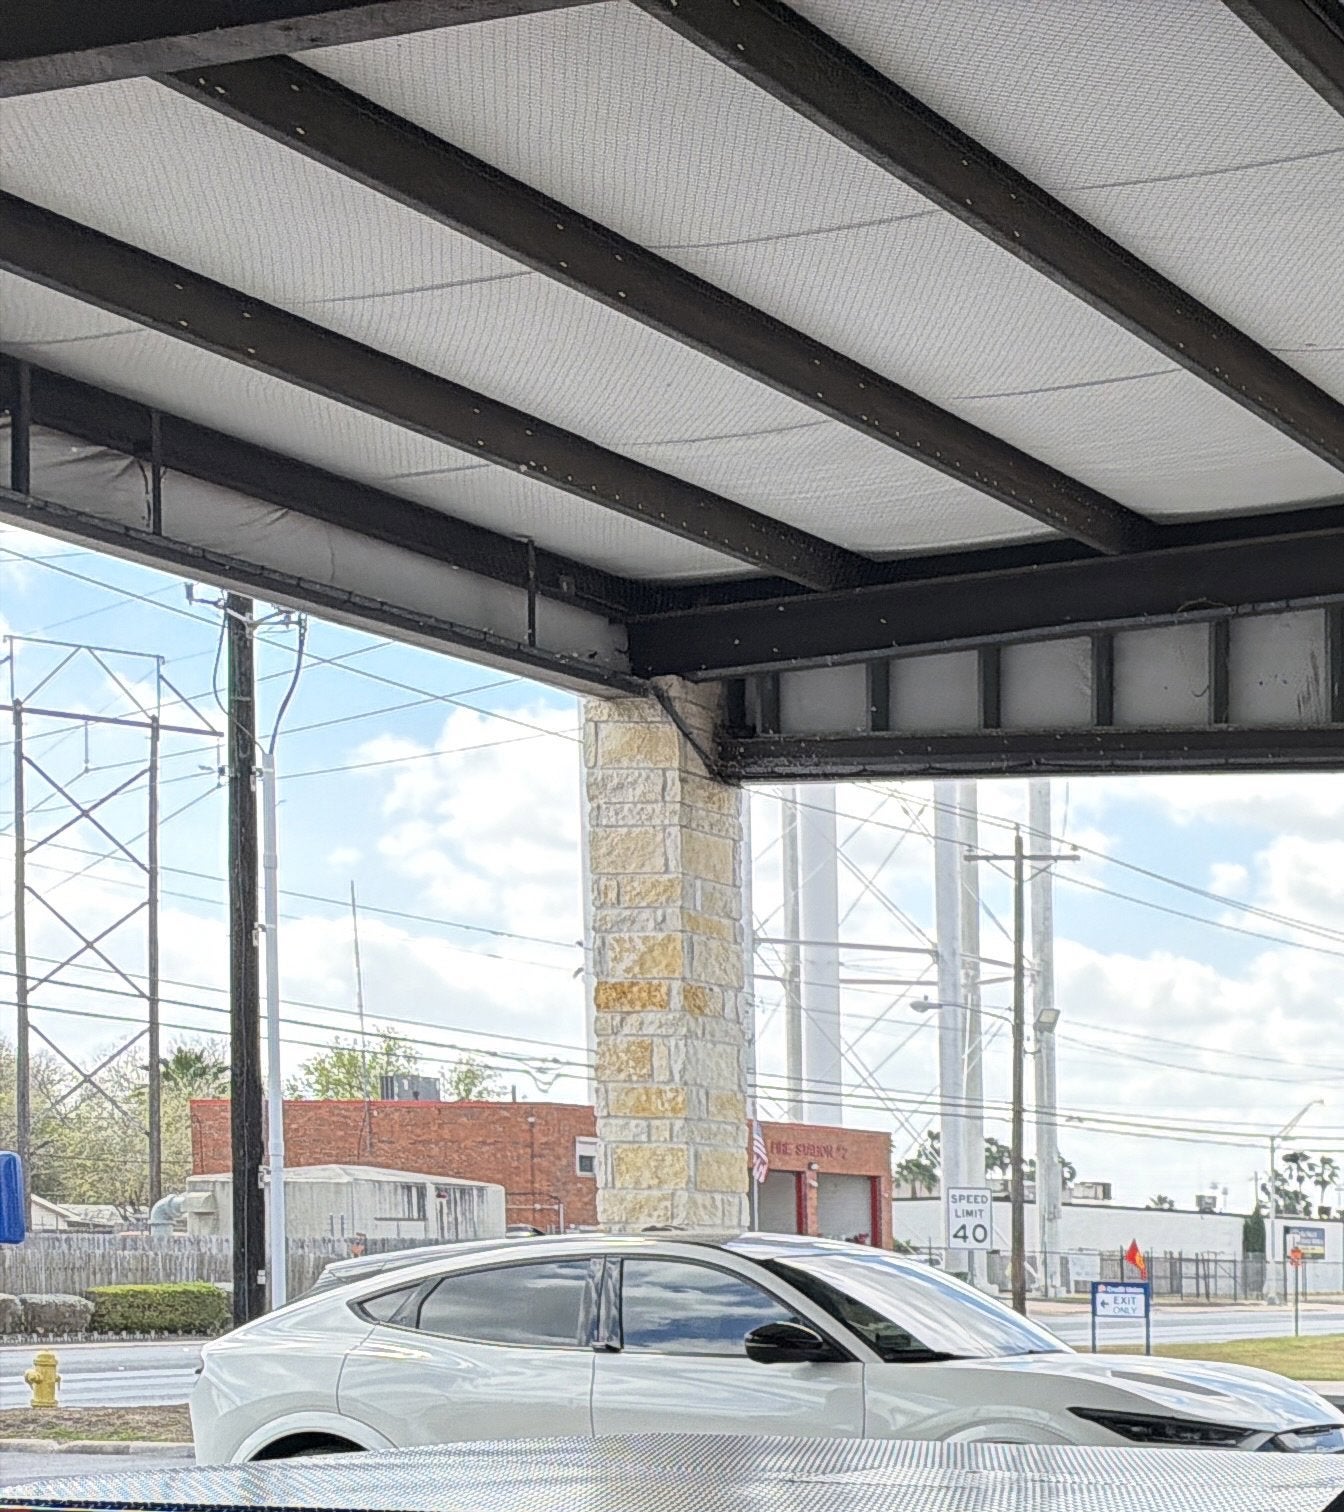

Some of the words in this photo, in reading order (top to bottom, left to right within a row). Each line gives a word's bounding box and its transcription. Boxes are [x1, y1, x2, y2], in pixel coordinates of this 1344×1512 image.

[951, 1194, 989, 1204] SPEED
[954, 1208, 985, 1219] LIMIT
[952, 1223, 988, 1244] 40
[1113, 1296, 1137, 1305] EXIT
[1113, 1306, 1137, 1315] ONLY
